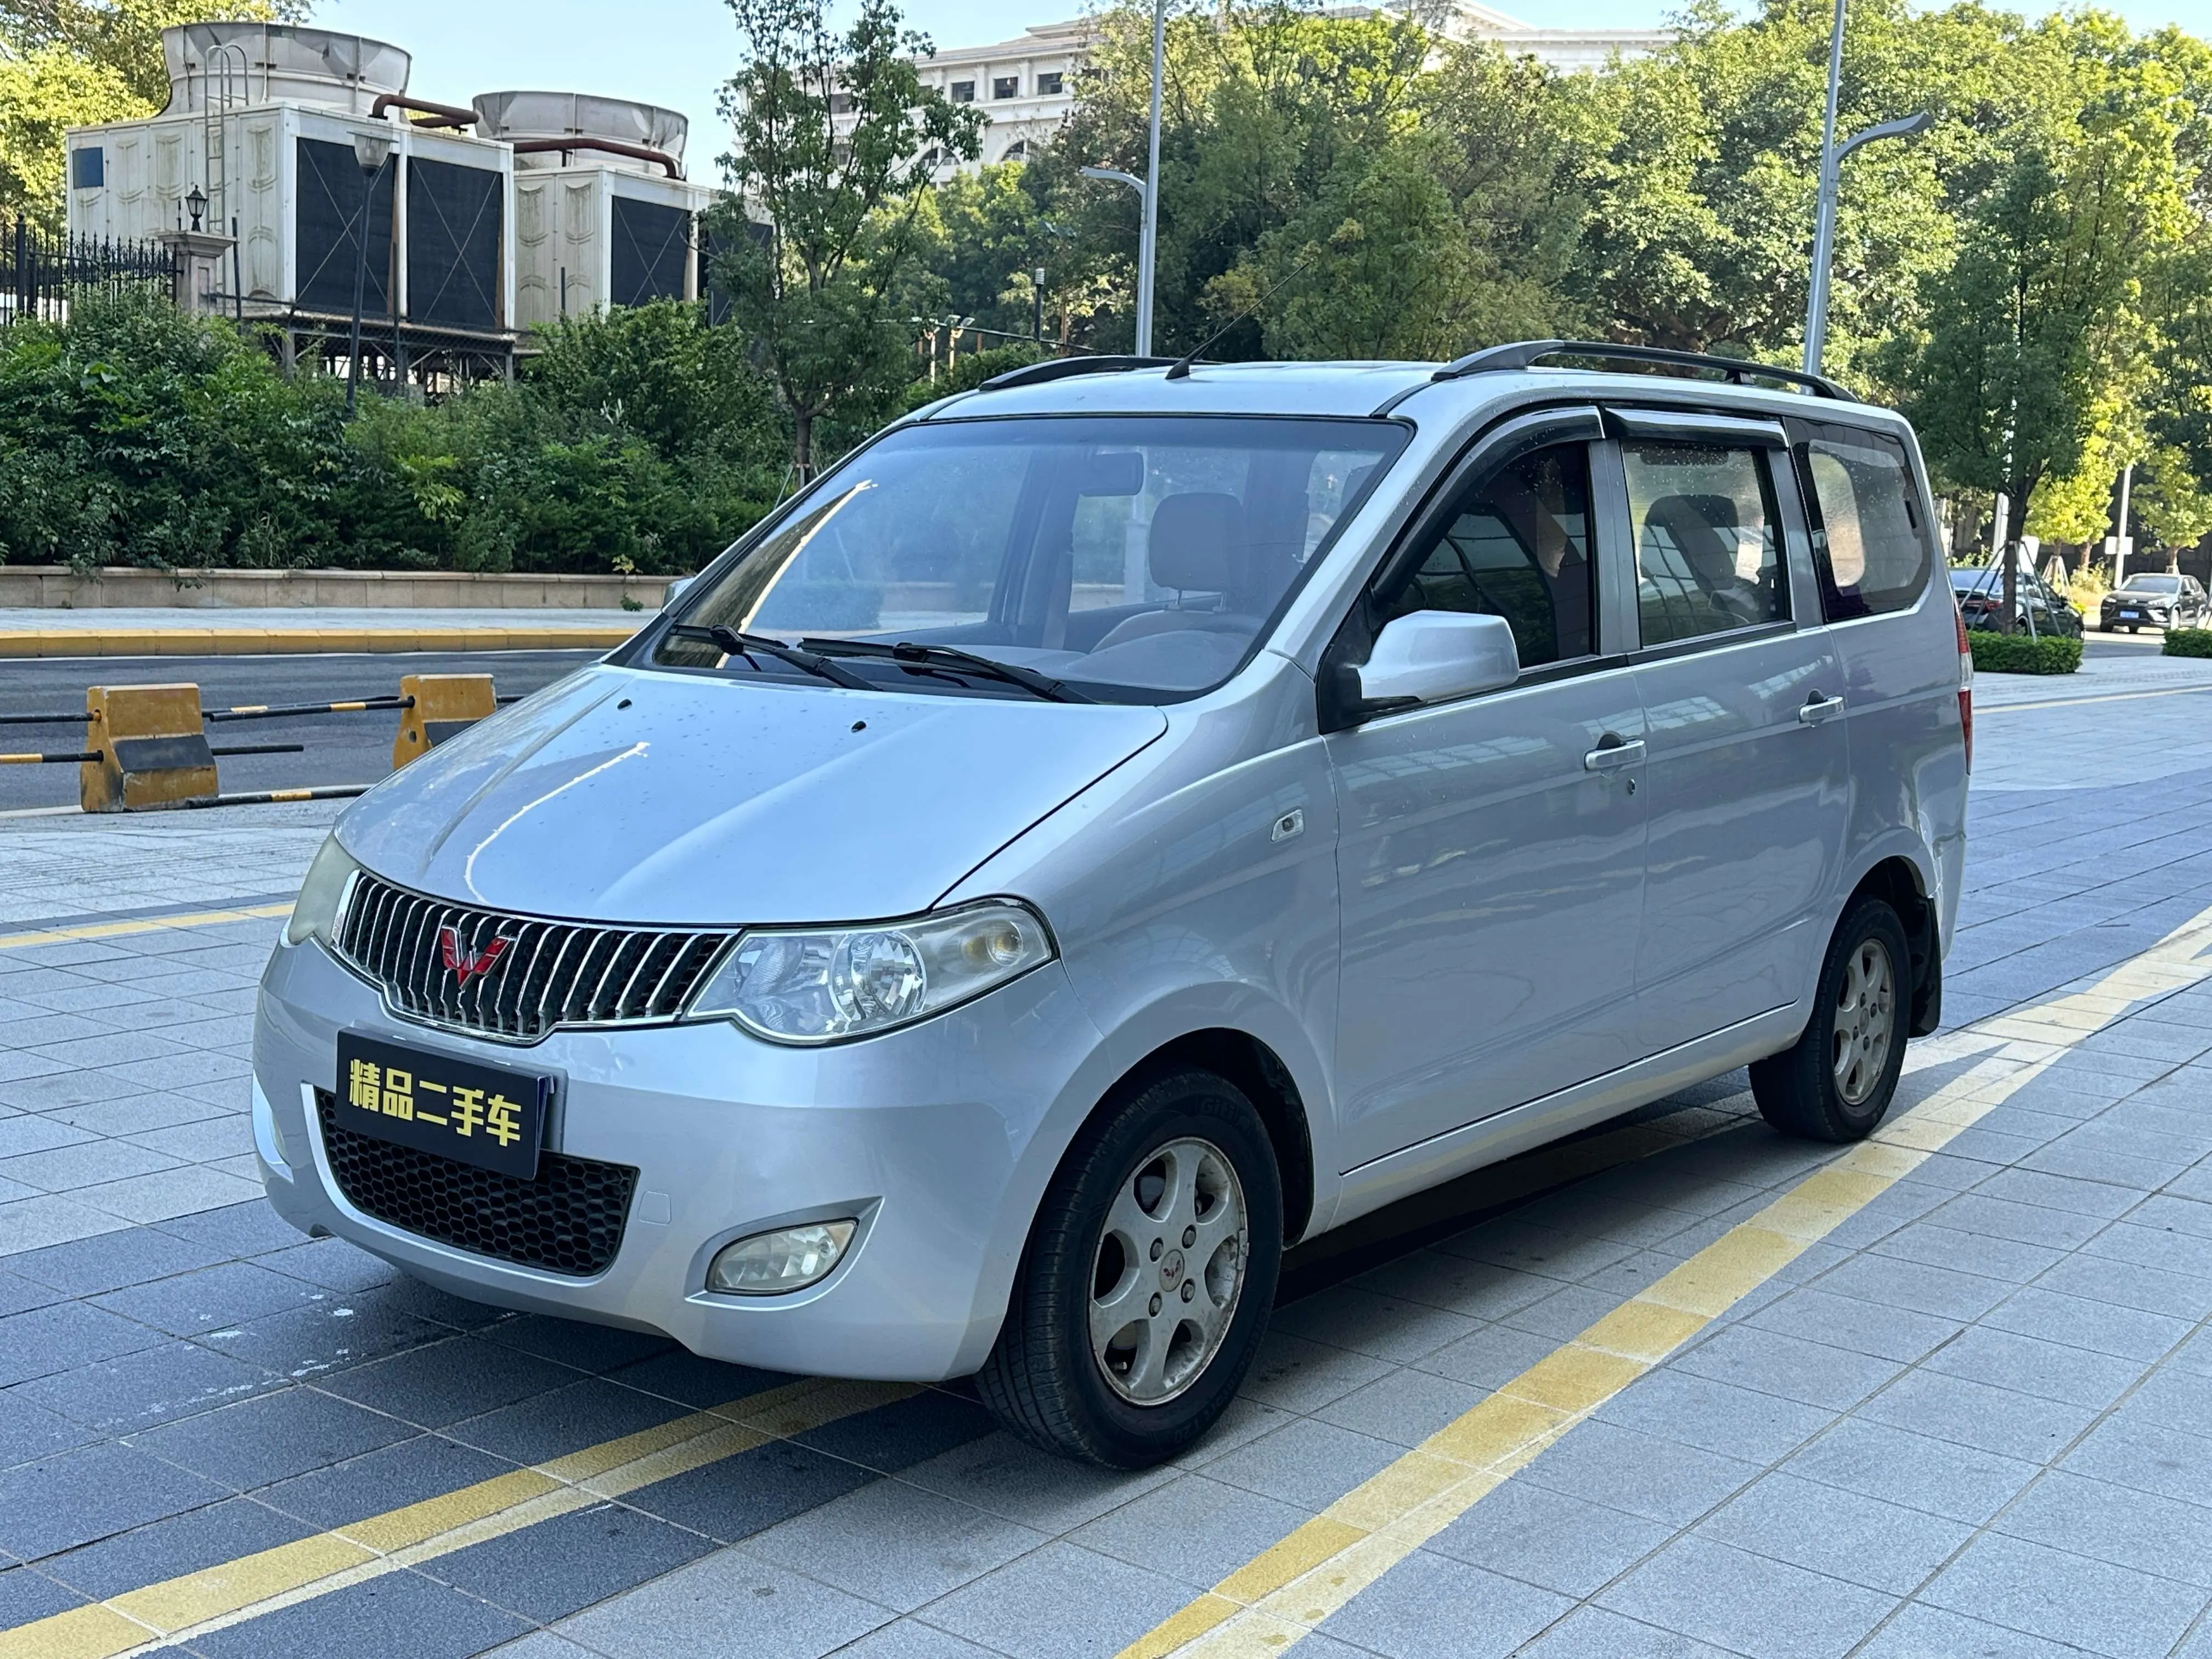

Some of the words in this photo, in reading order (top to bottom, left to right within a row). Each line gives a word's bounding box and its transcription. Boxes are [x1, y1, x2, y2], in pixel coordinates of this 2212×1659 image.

[349, 1059, 521, 1147] 精品二手车
[1200, 1098, 1235, 1122] Giti
